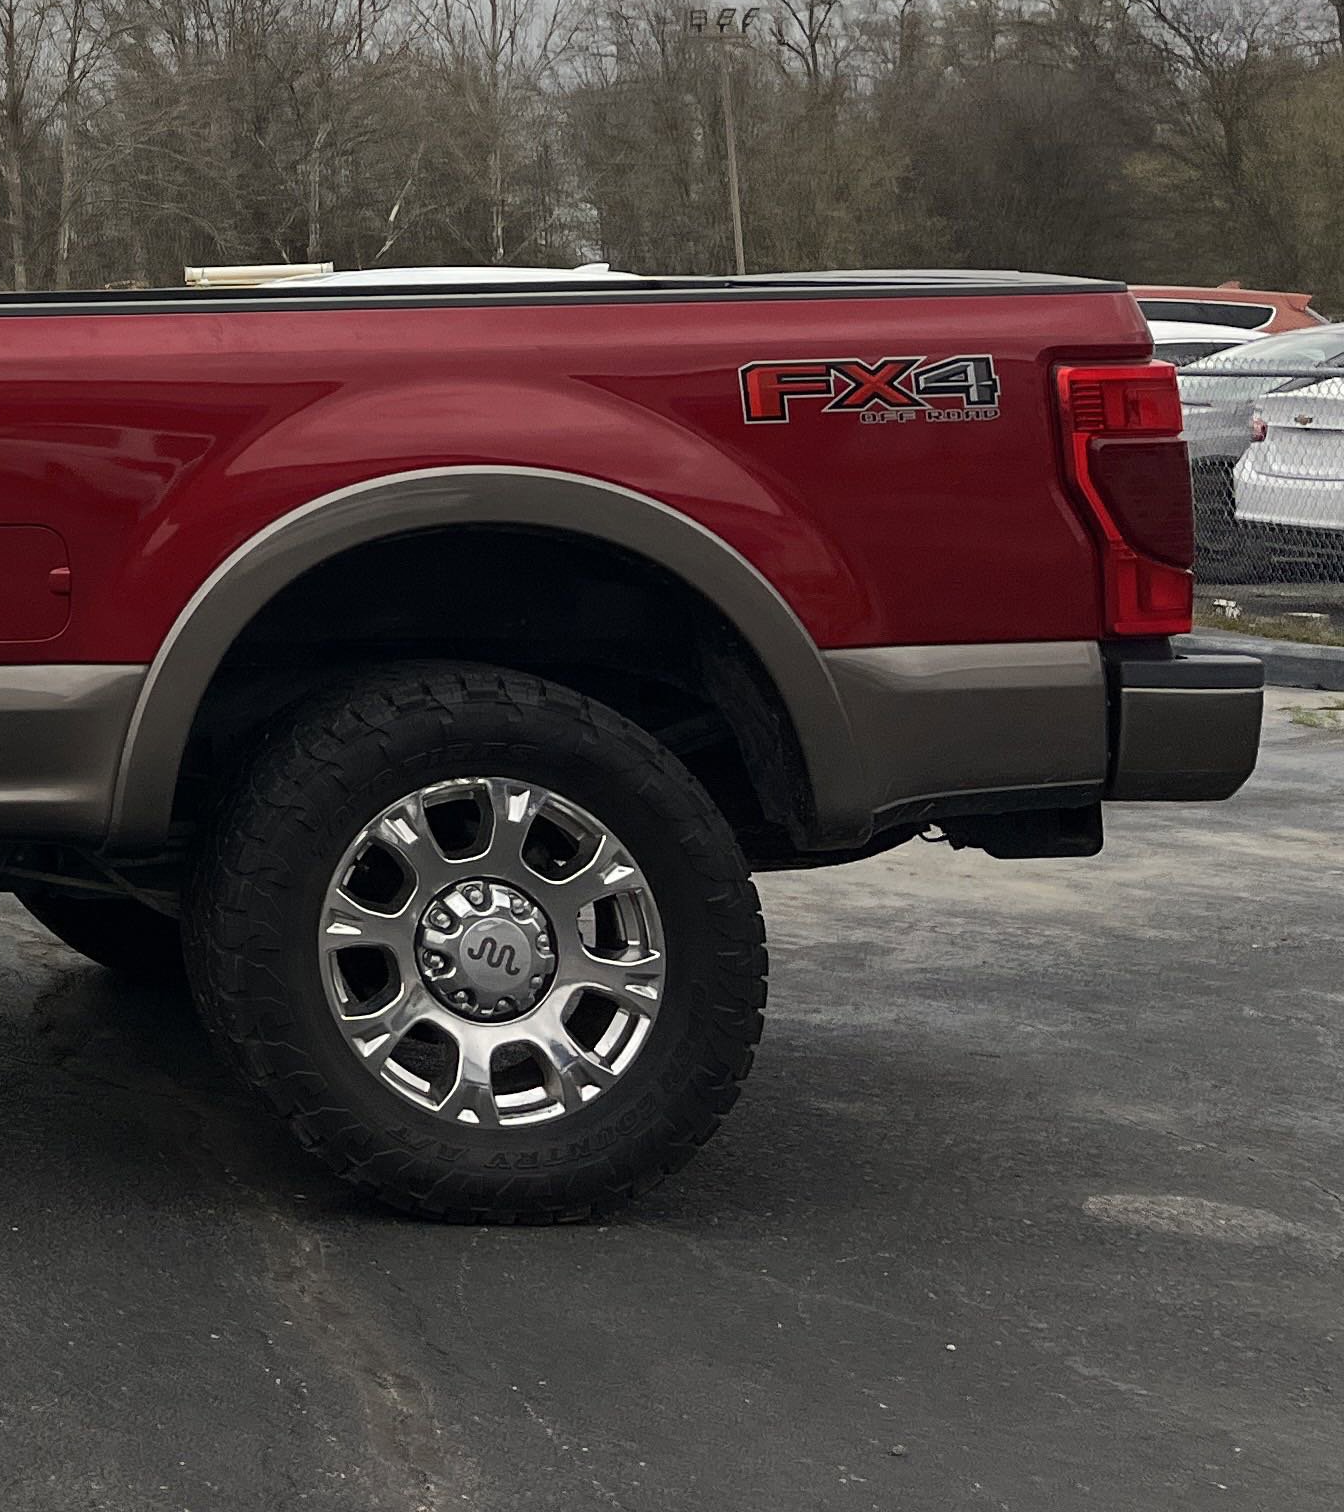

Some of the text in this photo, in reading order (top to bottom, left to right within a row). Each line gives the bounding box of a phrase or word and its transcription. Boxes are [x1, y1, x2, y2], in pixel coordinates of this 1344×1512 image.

[738, 354, 1001, 424] FX4
[859, 408, 1001, 424] OFF ROAD
